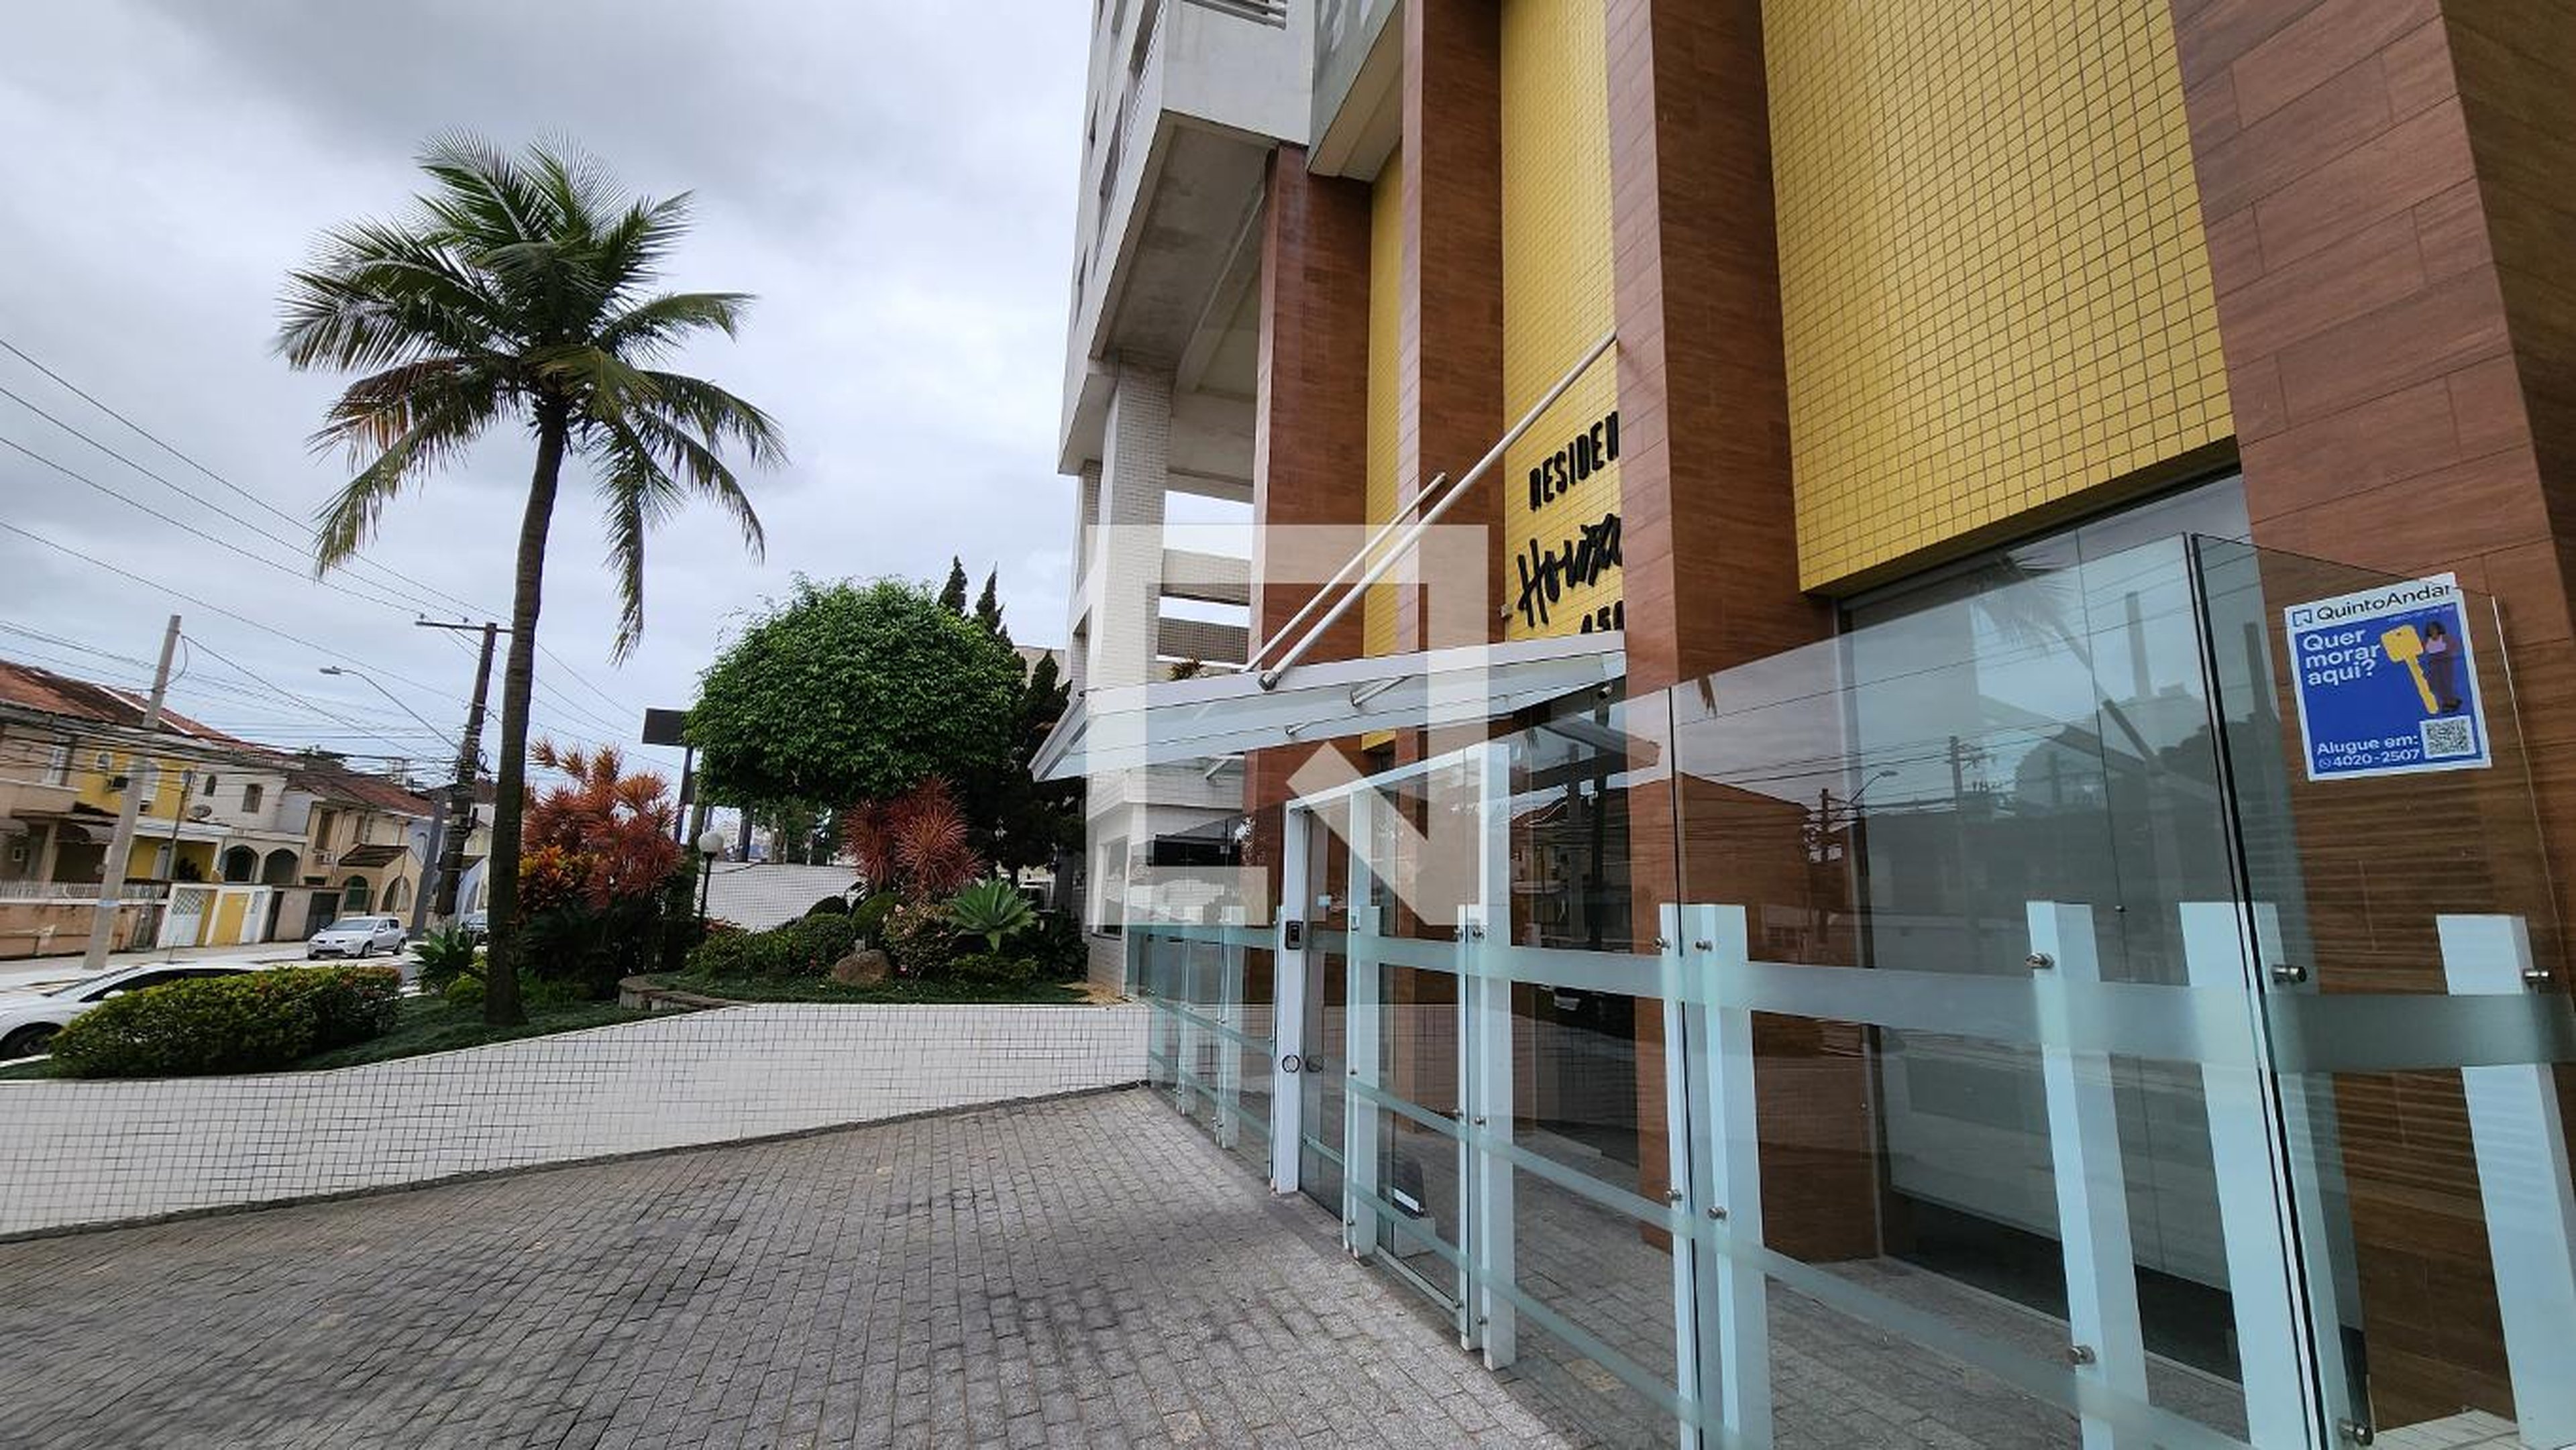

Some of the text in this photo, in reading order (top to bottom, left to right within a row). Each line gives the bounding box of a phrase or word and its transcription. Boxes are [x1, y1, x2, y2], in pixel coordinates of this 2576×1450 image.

[2316, 585, 2449, 620] QuintoAndar
[2303, 629, 2366, 651] Quer
[2306, 645, 2380, 669] morar
[2308, 659, 2375, 685] aqui?
[2317, 735, 2418, 755] Alugue em:
[2333, 748, 2420, 767] 4020-2507
